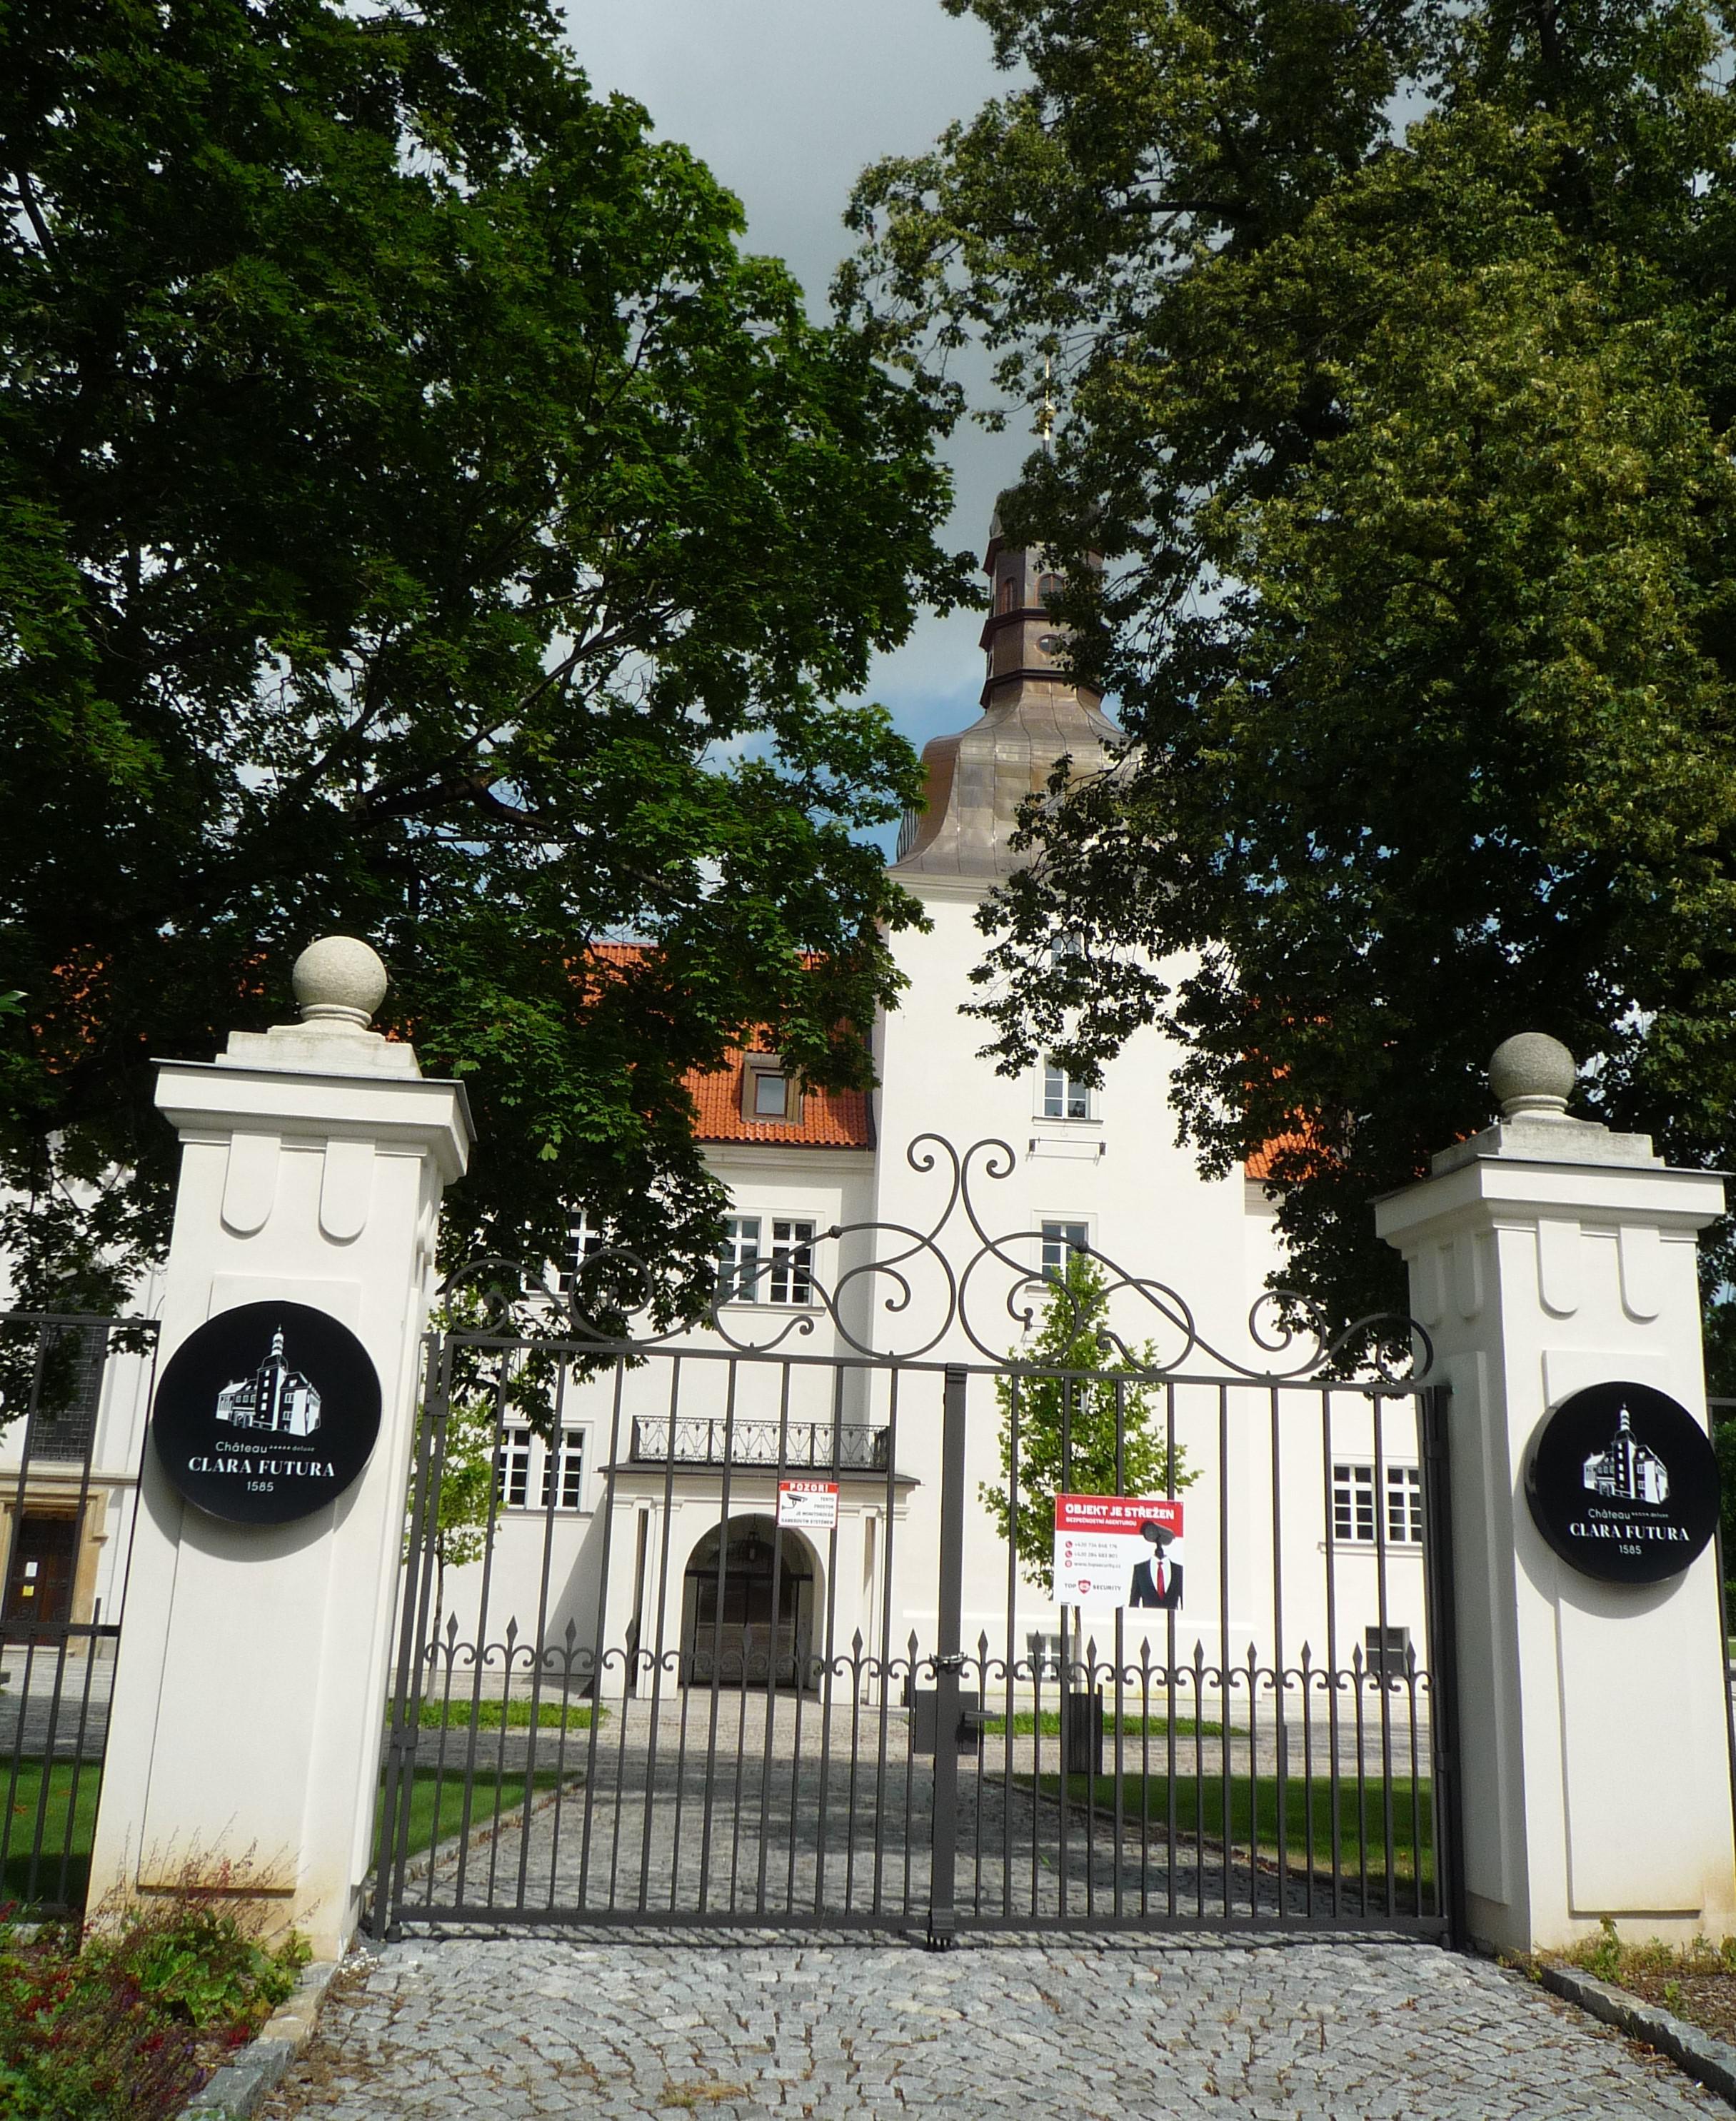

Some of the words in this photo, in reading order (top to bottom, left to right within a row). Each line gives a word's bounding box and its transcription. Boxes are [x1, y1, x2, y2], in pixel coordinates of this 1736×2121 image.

[215, 1441, 268, 1453] Château
[188, 1457, 252, 1473] CLARA
[258, 1460, 336, 1477] FUTURA
[246, 1481, 274, 1493] 1585
[789, 1483, 828, 1493] POZOR!
[1065, 1503, 1108, 1515] OBJEKT
[1110, 1506, 1123, 1516] JE
[1125, 1505, 1175, 1520] STŘEŽEN
[1587, 1508, 1631, 1520] Château
[1065, 1516, 1105, 1525] BEZPEČNOSTNÍ
[1569, 1523, 1622, 1538] CLARA
[1625, 1525, 1690, 1541] FUTURA
[1618, 1545, 1642, 1555] 1585
